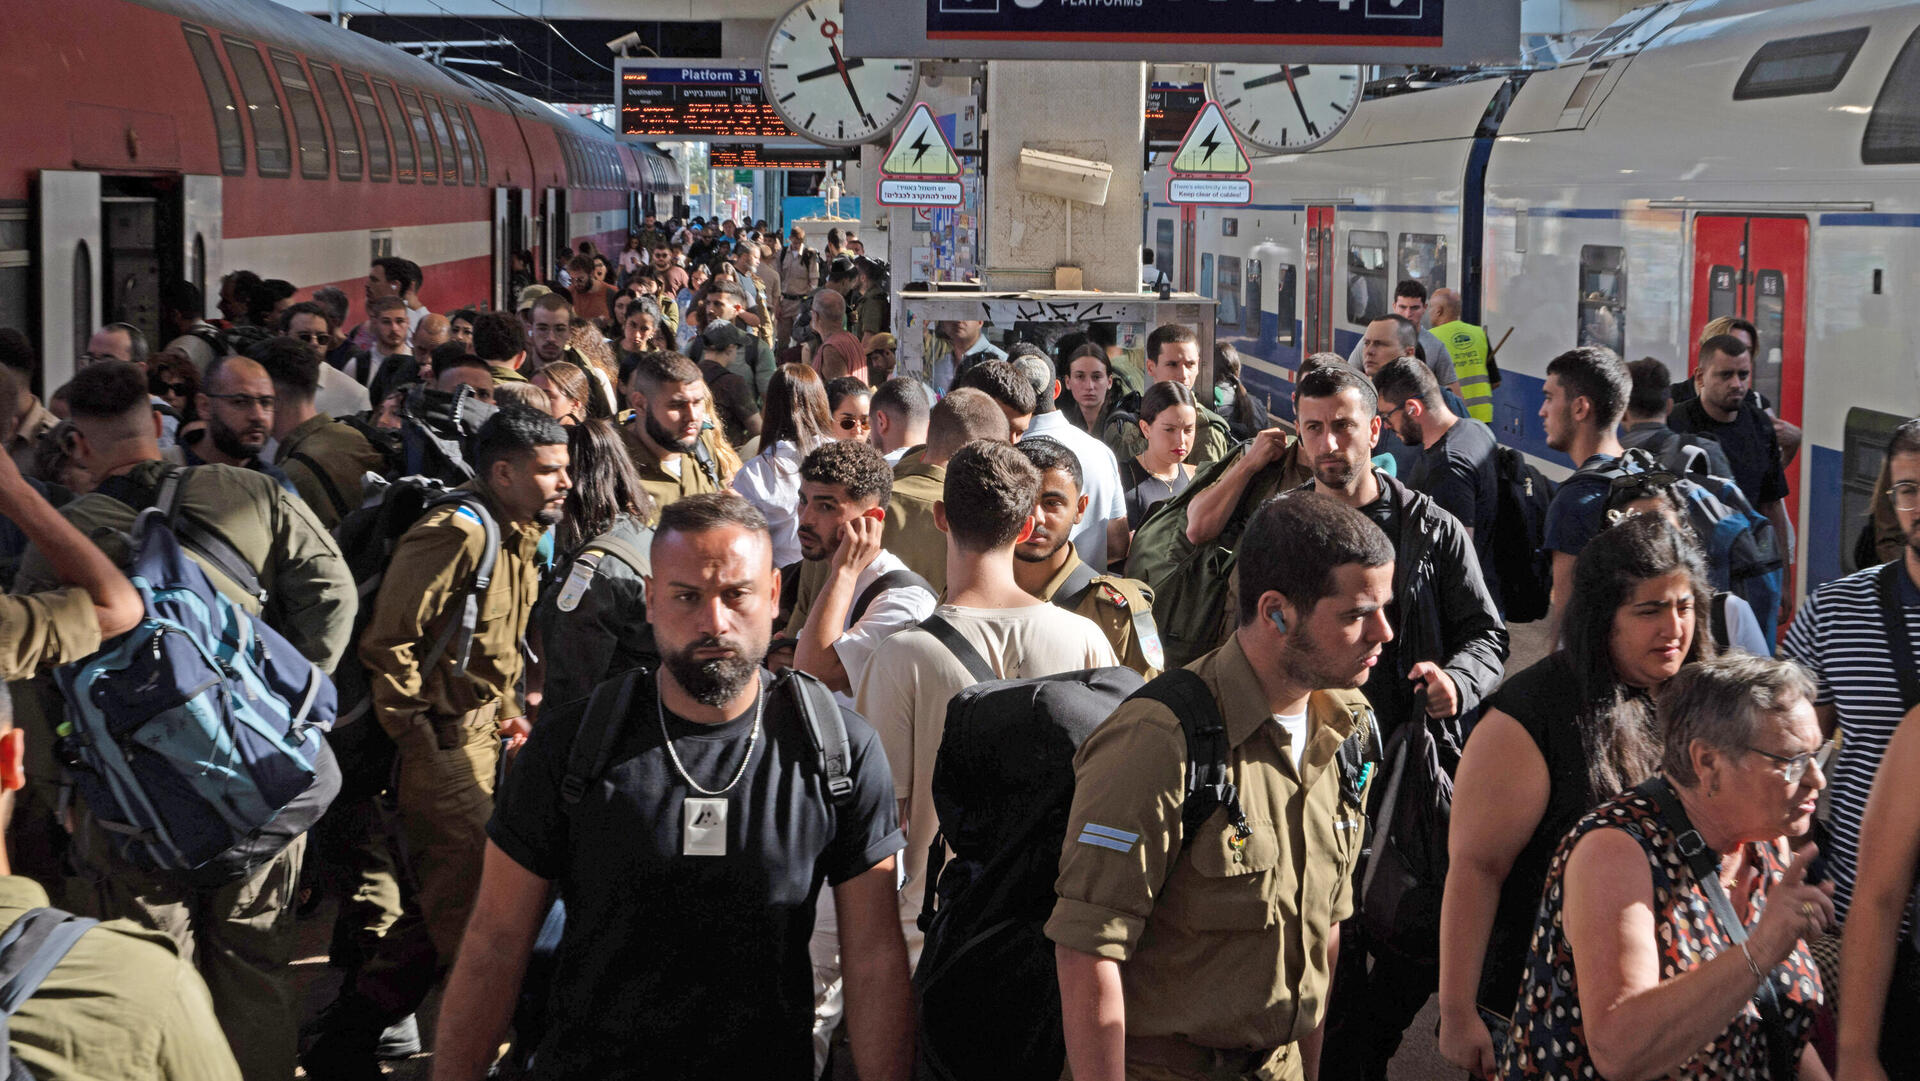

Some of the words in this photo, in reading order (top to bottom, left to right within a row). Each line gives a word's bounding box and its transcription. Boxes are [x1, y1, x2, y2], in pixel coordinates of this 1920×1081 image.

[681, 69, 733, 81] Platform
[739, 70, 747, 81] 3
[628, 88, 663, 97] Destination
[912, 192, 939, 201] להתקרב
